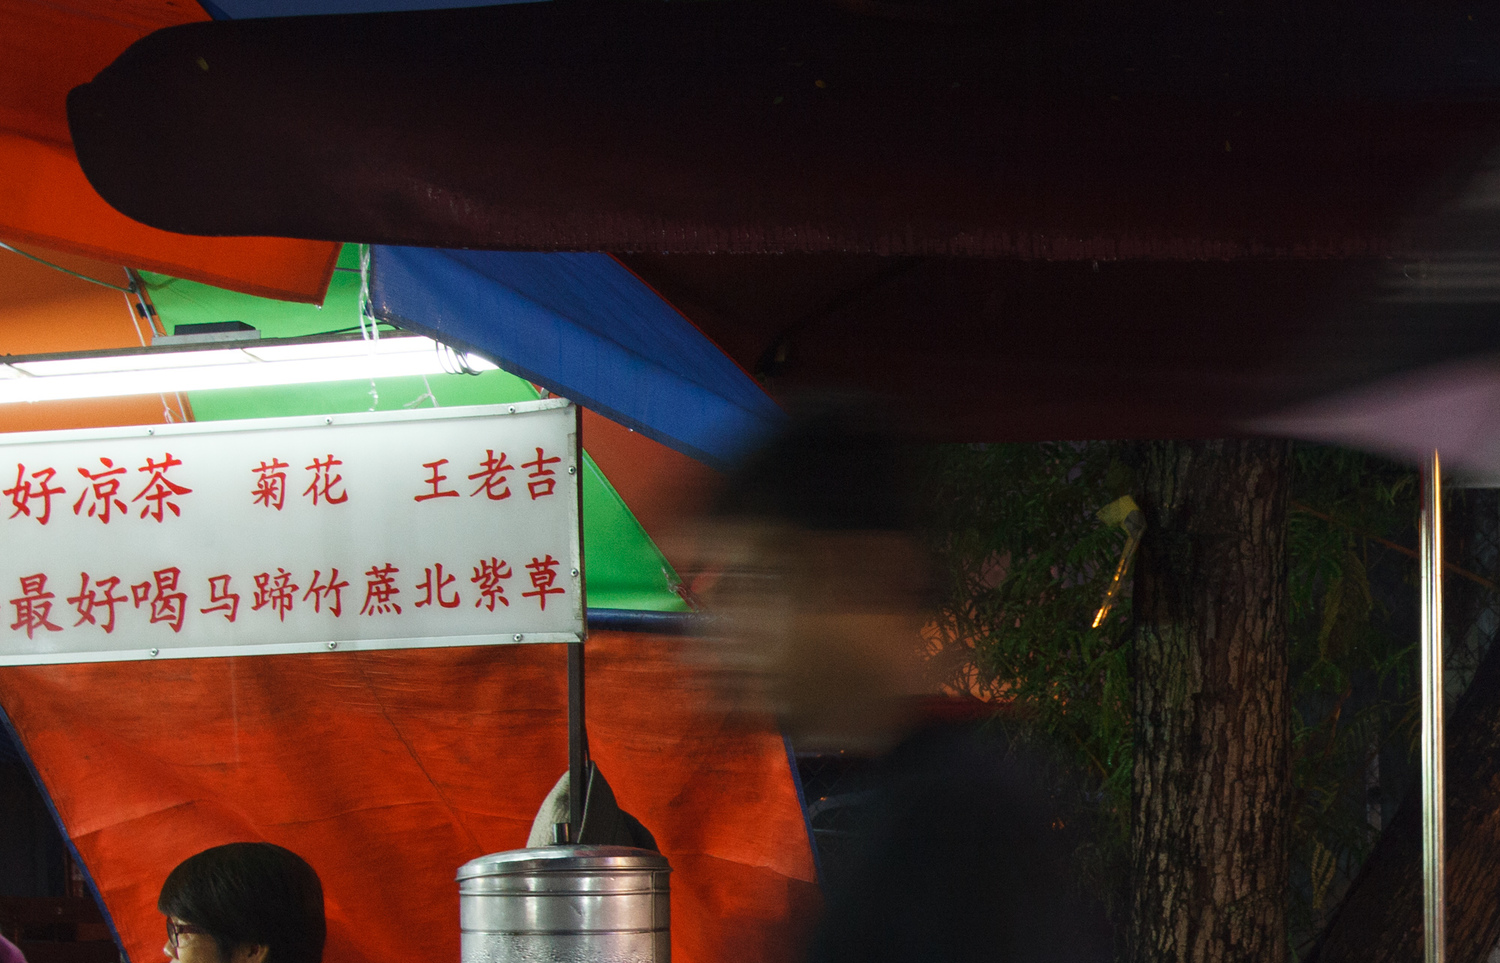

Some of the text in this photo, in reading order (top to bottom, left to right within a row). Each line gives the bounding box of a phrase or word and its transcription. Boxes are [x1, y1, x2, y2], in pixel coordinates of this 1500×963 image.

[2, 447, 562, 526] 好凉茶 菊花 王老吉
